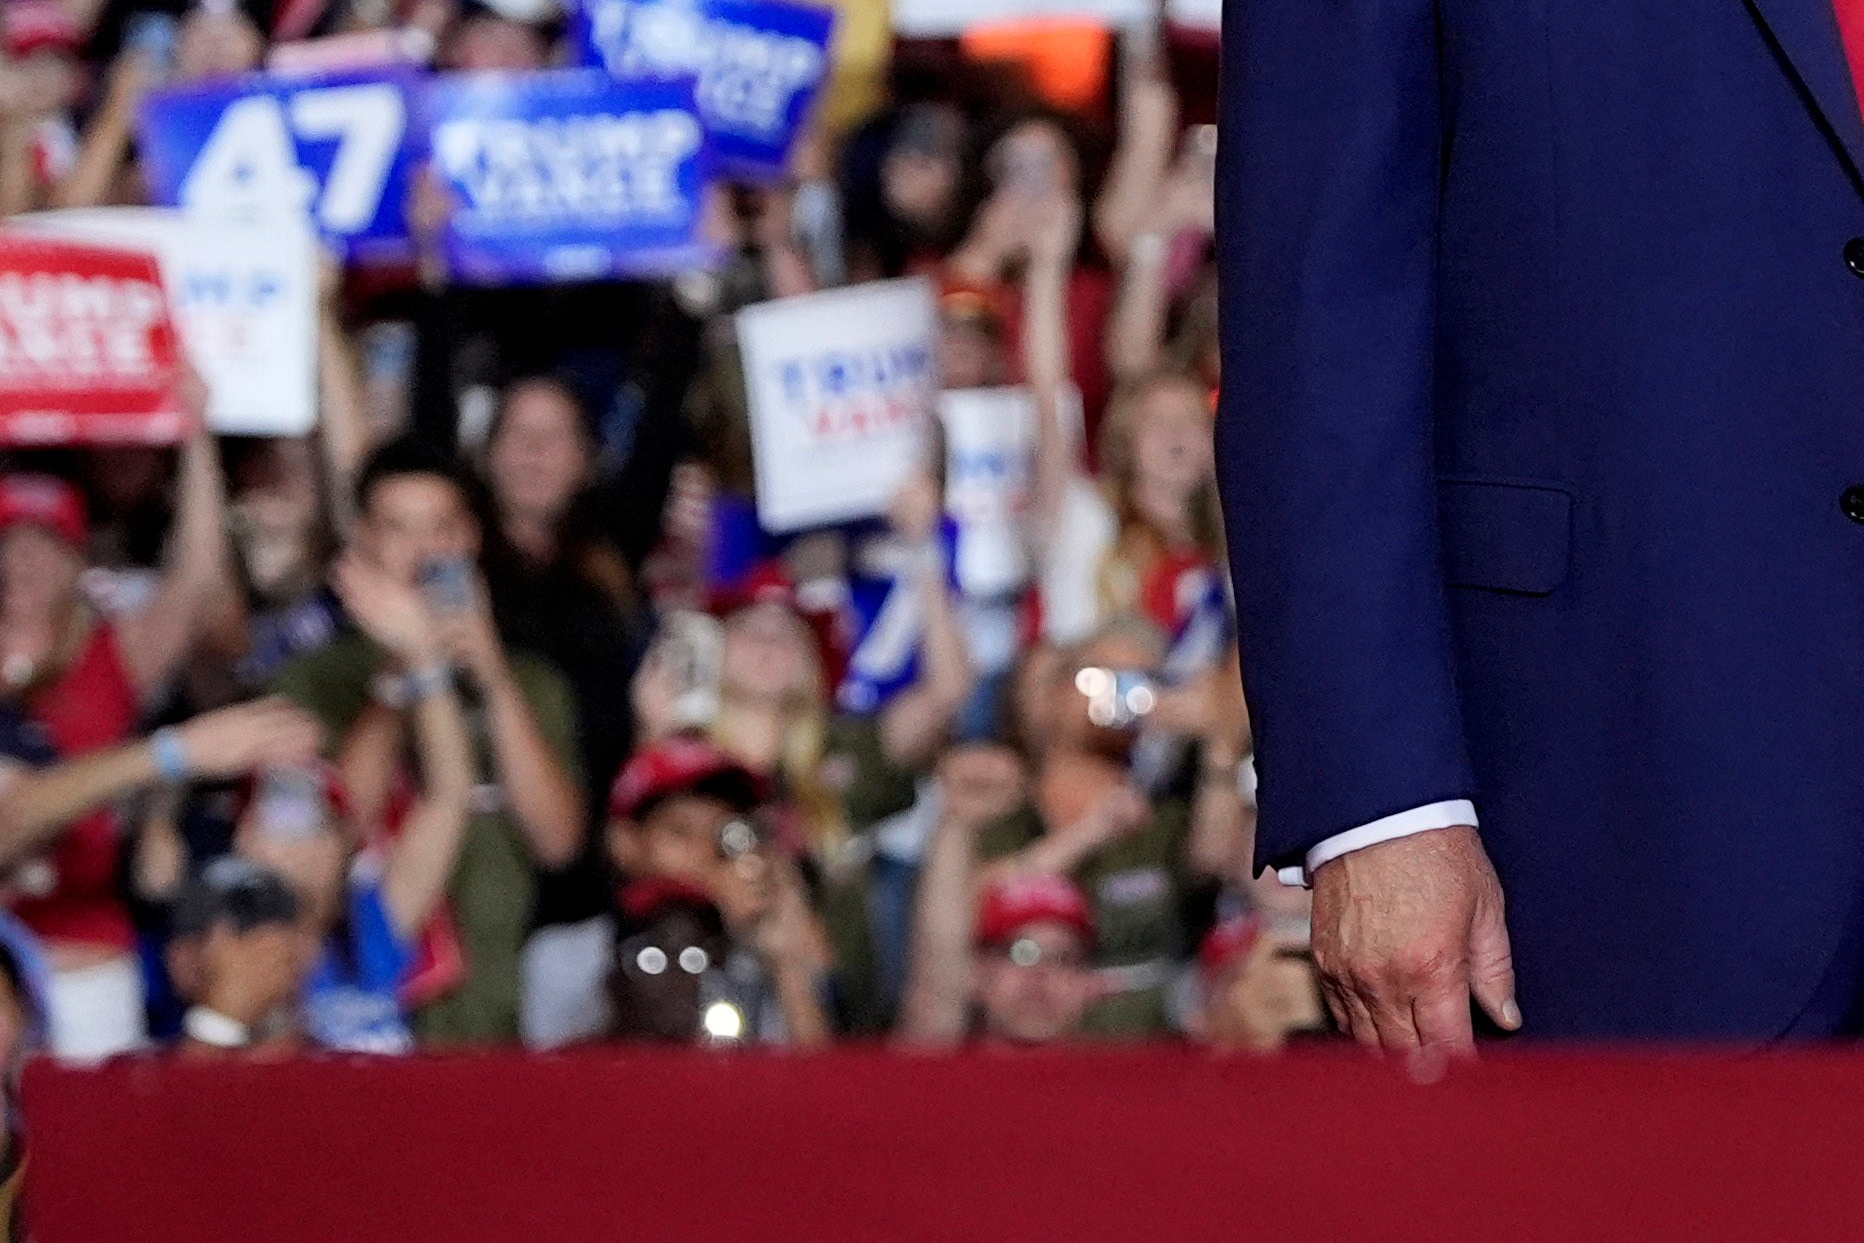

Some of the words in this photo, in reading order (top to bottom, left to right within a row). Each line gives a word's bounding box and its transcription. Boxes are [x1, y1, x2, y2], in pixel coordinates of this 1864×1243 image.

[177, 84, 404, 234] 47
[433, 110, 700, 164] TRUMP
[468, 160, 682, 214] VANCE
[0, 270, 158, 318] UMP
[780, 346, 928, 401] TRUM
